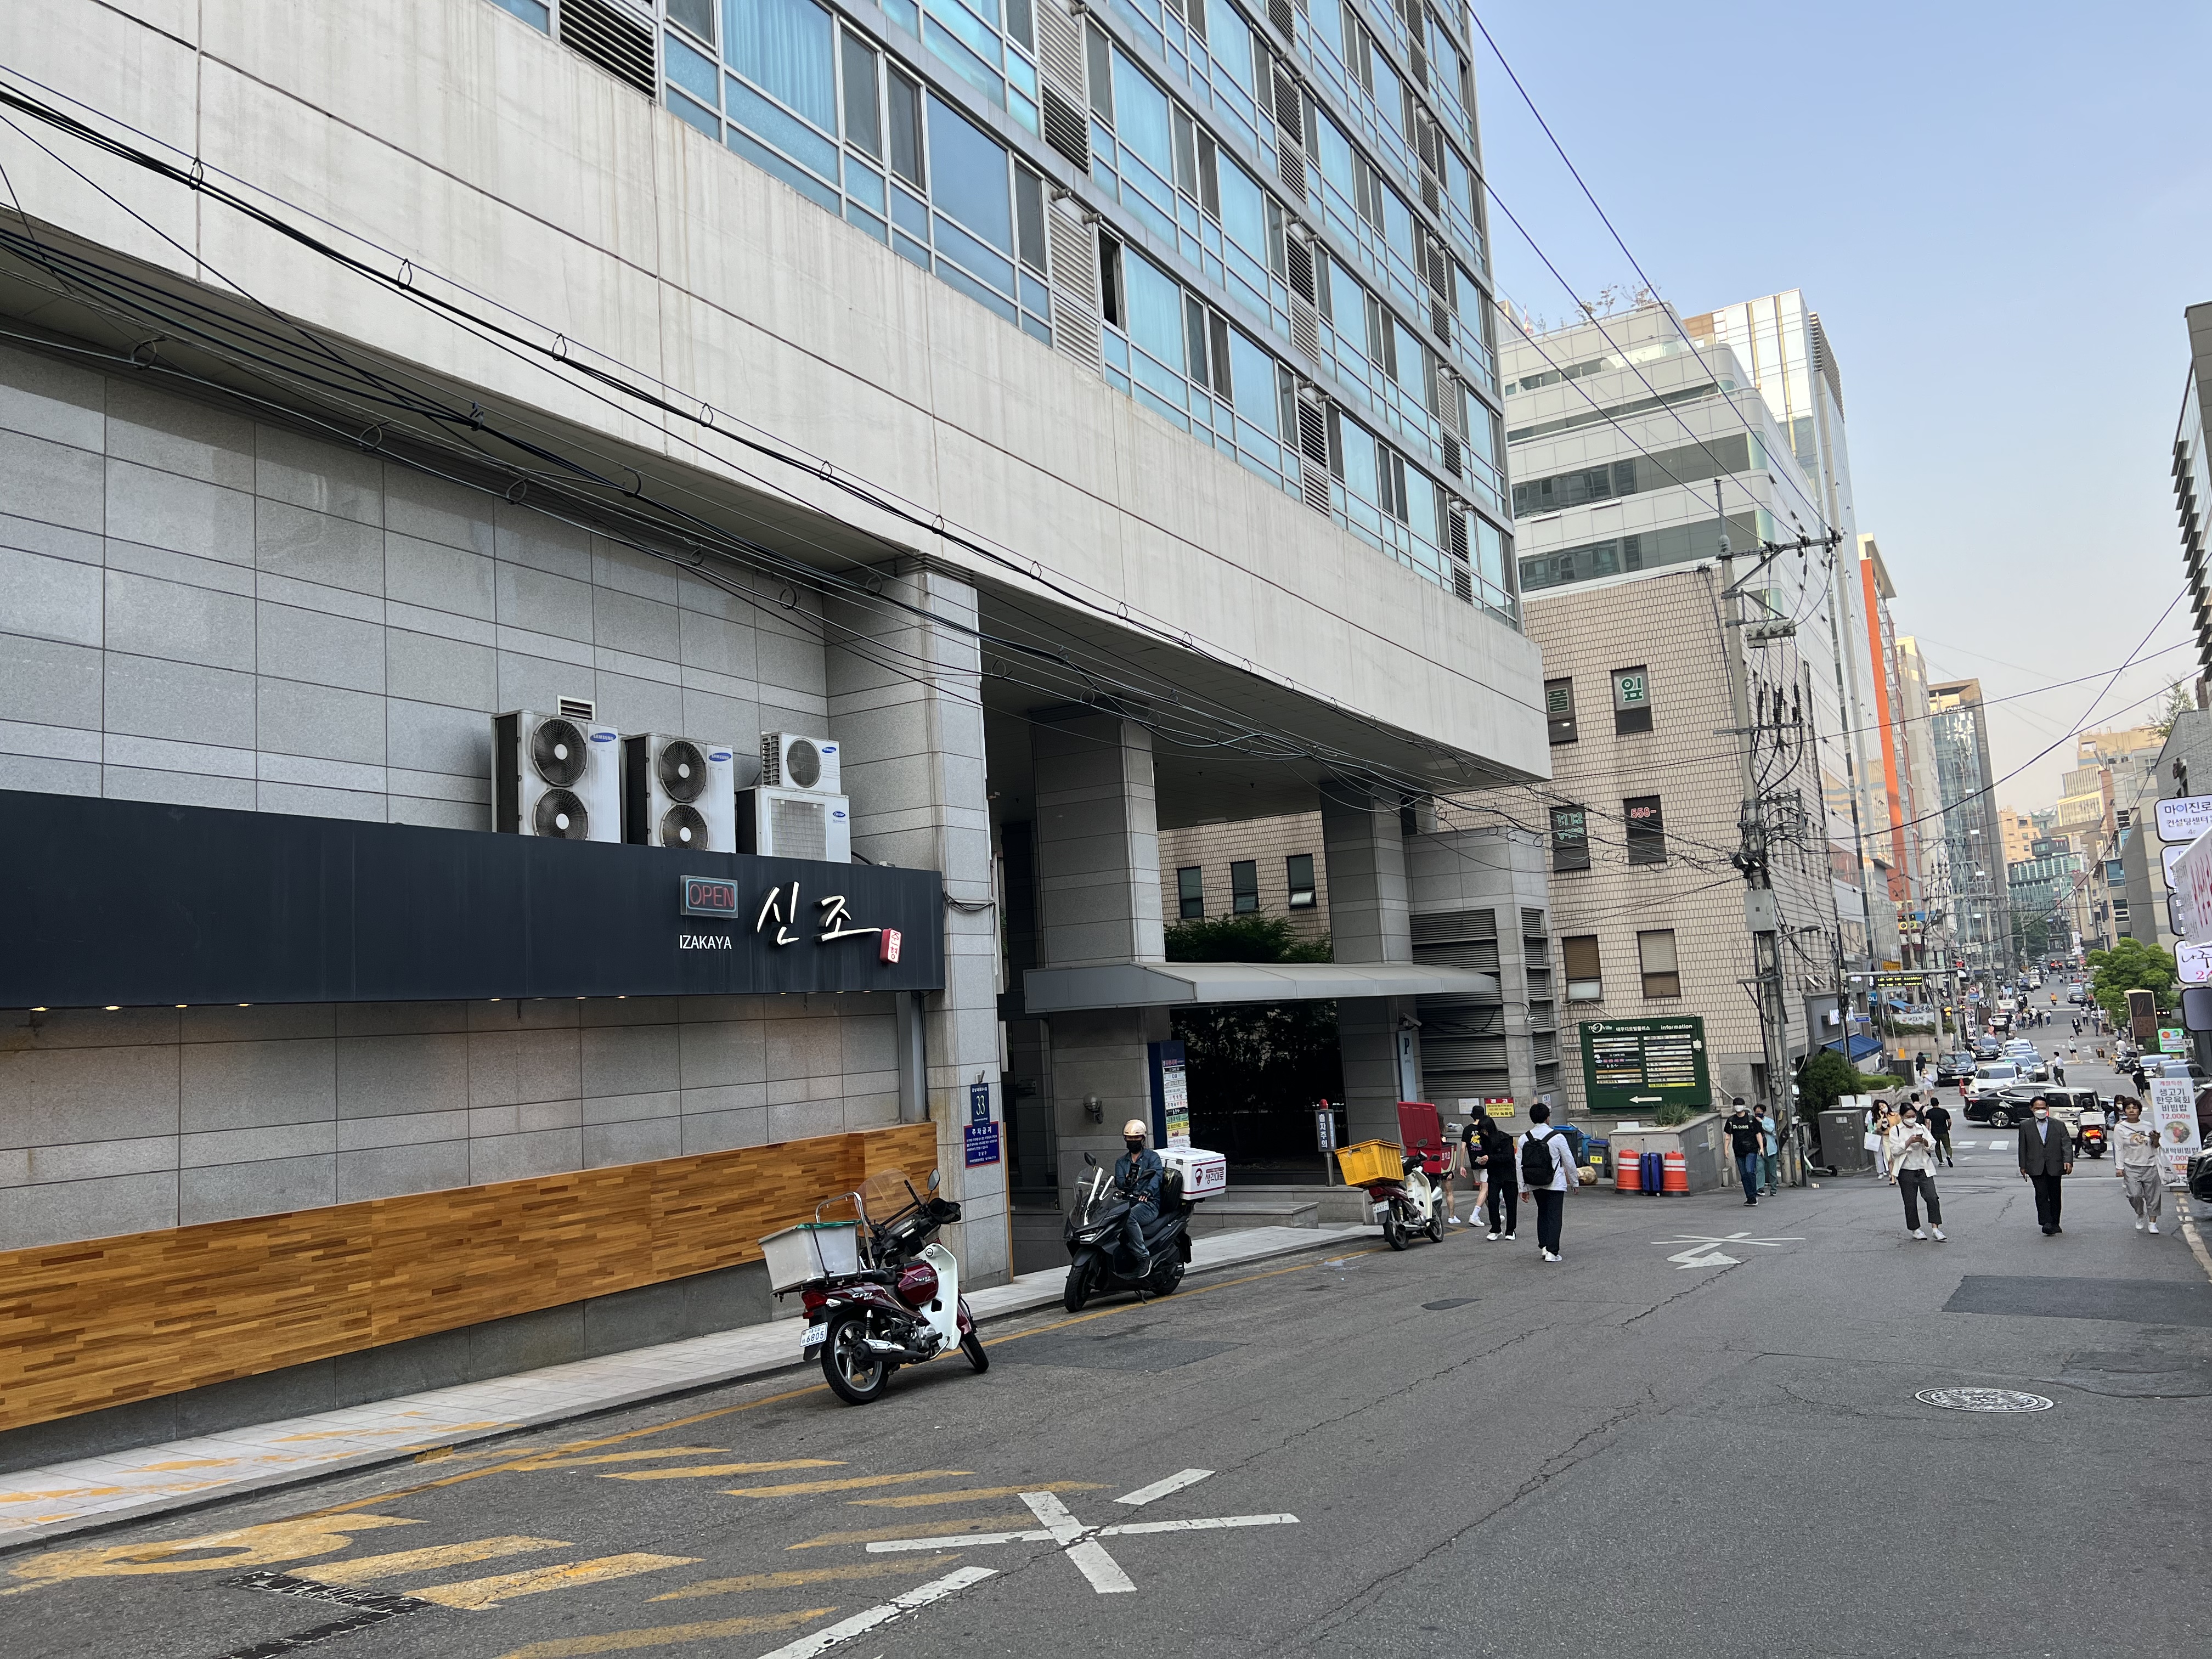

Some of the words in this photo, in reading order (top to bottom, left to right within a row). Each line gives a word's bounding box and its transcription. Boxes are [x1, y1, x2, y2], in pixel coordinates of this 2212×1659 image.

[1620, 675, 1644, 703] 잎
[2164, 802, 2212, 814] 마이진로
[1570, 812, 1583, 825] 1:2
[689, 884, 734, 907] OPEN
[757, 881, 882, 946] 신조
[679, 935, 732, 950] IZAKAYA
[1403, 1037, 1410, 1055] P
[2159, 1088, 2185, 1096] 생고기
[976, 1094, 985, 1115] 33
[2156, 1096, 2191, 1104] 한우육회
[972, 1126, 992, 1136] 주차금지
[1441, 1151, 1451, 1161] 요기요
[1205, 1171, 1224, 1184] 생각대로
[806, 1330, 825, 1343] 6805
